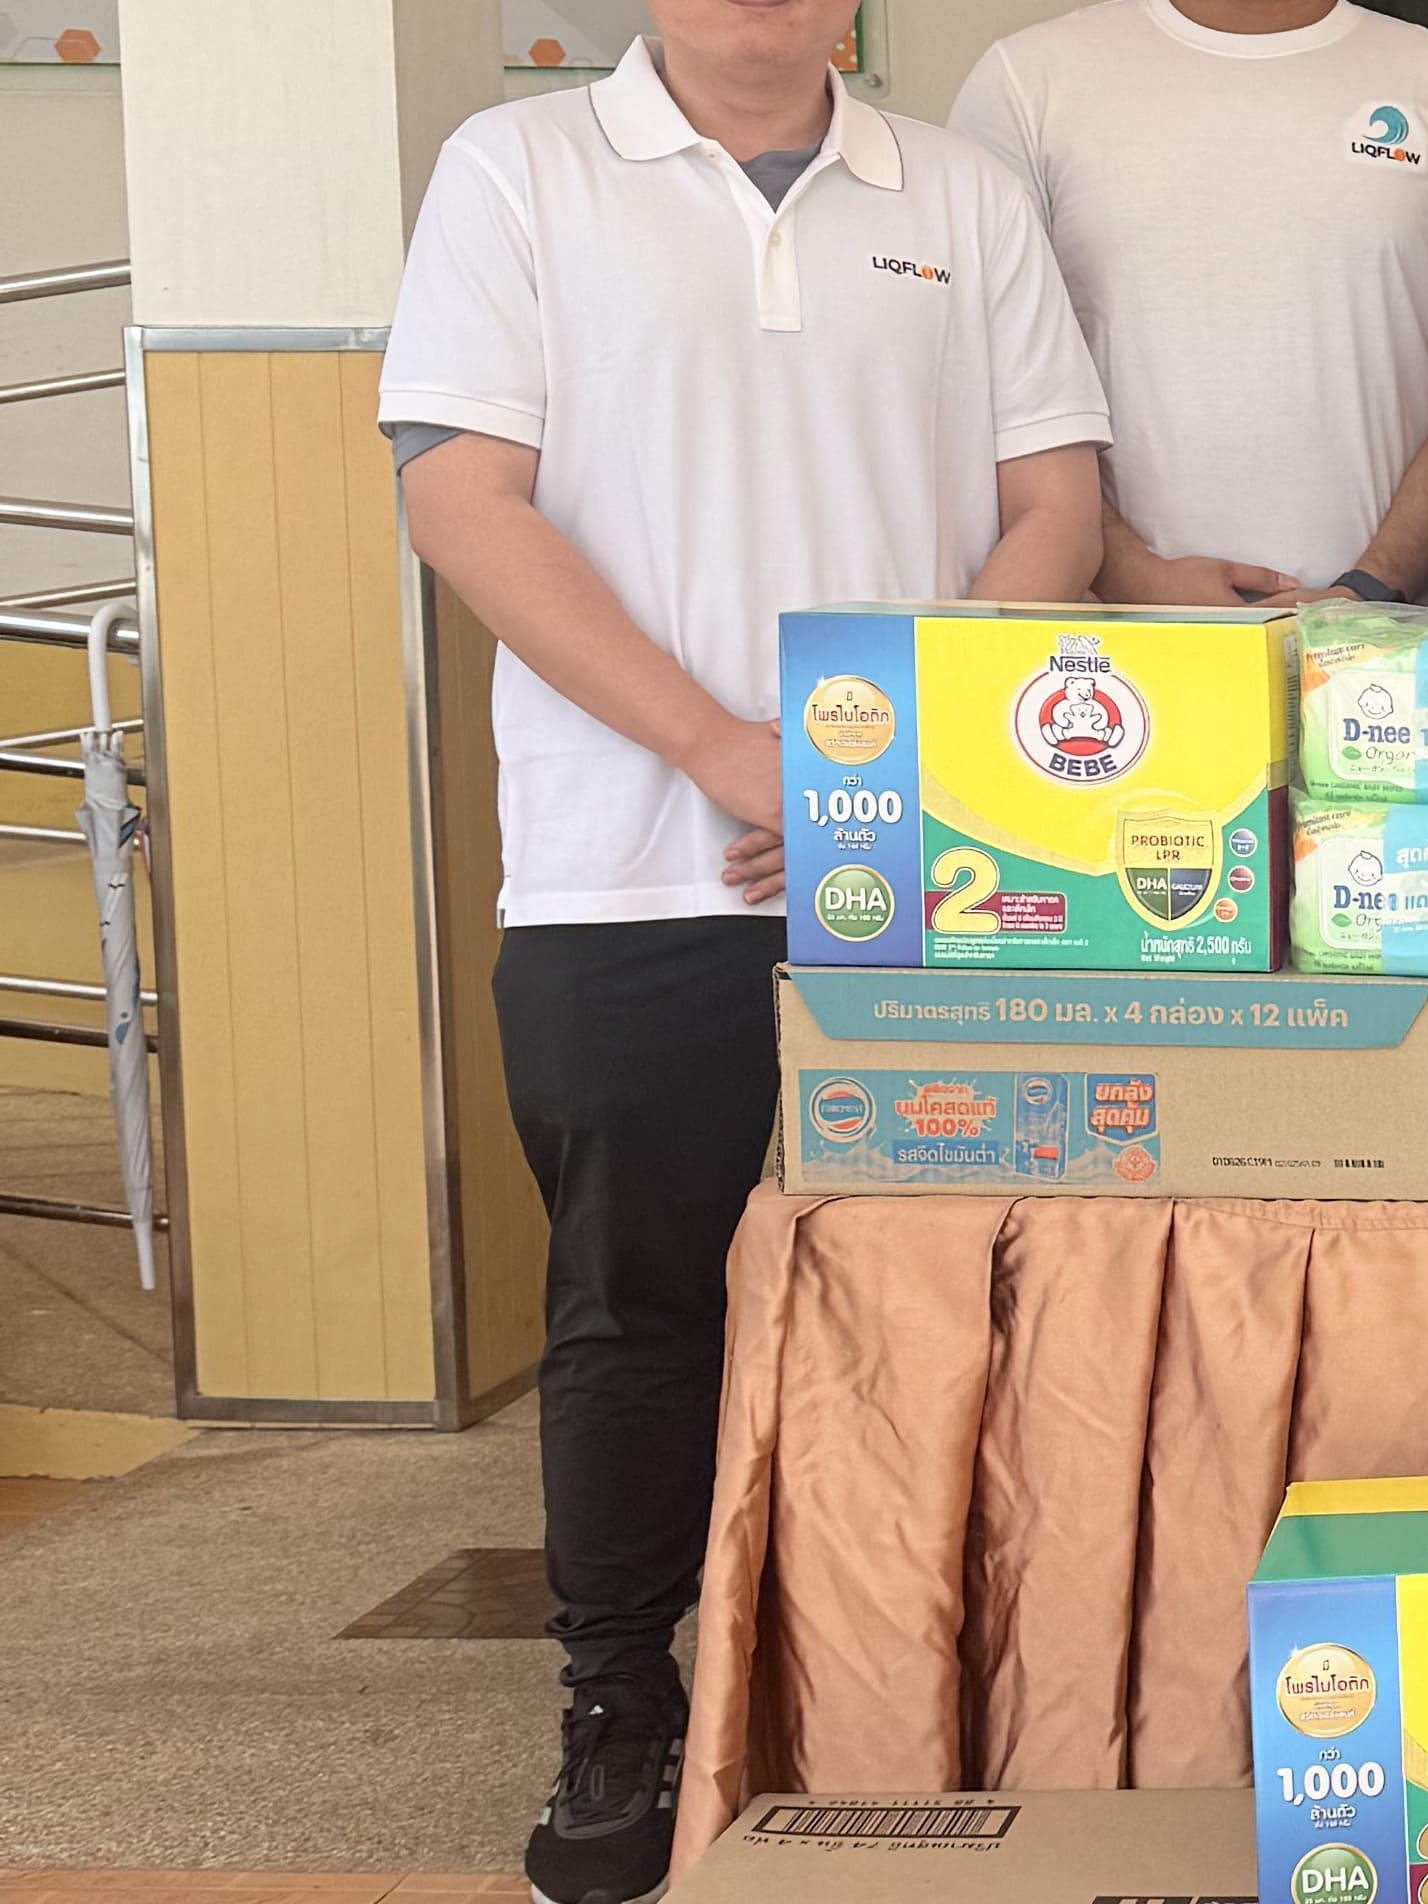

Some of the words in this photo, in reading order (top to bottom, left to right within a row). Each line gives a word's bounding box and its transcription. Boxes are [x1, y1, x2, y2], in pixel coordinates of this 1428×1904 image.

[1351, 141, 1421, 165] LIQFLOW
[872, 256, 951, 284] LIQFLOW
[812, 704, 889, 722] โพรไบโอติก
[1343, 717, 1411, 744] D-nee
[1049, 753, 1118, 777] BEBE
[803, 789, 902, 827] 1,000
[1131, 835, 1204, 848] PROBIOTIC
[931, 847, 1000, 934] 2
[1135, 877, 1167, 890] DHA
[824, 886, 887, 911] DHA
[1197, 936, 1229, 955] 2,500
[1231, 938, 1251, 955] กรัม
[996, 998, 1048, 1022] 180
[1055, 1002, 1098, 1023] มล.
[1104, 1006, 1118, 1023] x
[1123, 1001, 1143, 1023] 4
[1149, 999, 1225, 1030] กล่อง
[1248, 1002, 1281, 1028] 12
[1285, 1001, 1349, 1028] แพ็ค
[1094, 1080, 1152, 1103] ยกลัง
[894, 1096, 997, 1116] นมโคสดแท้
[914, 1118, 981, 1137] 100%
[1090, 1105, 1150, 1134] สุดคุ้ม
[897, 1143, 995, 1164] รสจืดไขมันต่ำ
[1276, 1762, 1385, 1806] 1,000
[1301, 1865, 1369, 1893] DHA
